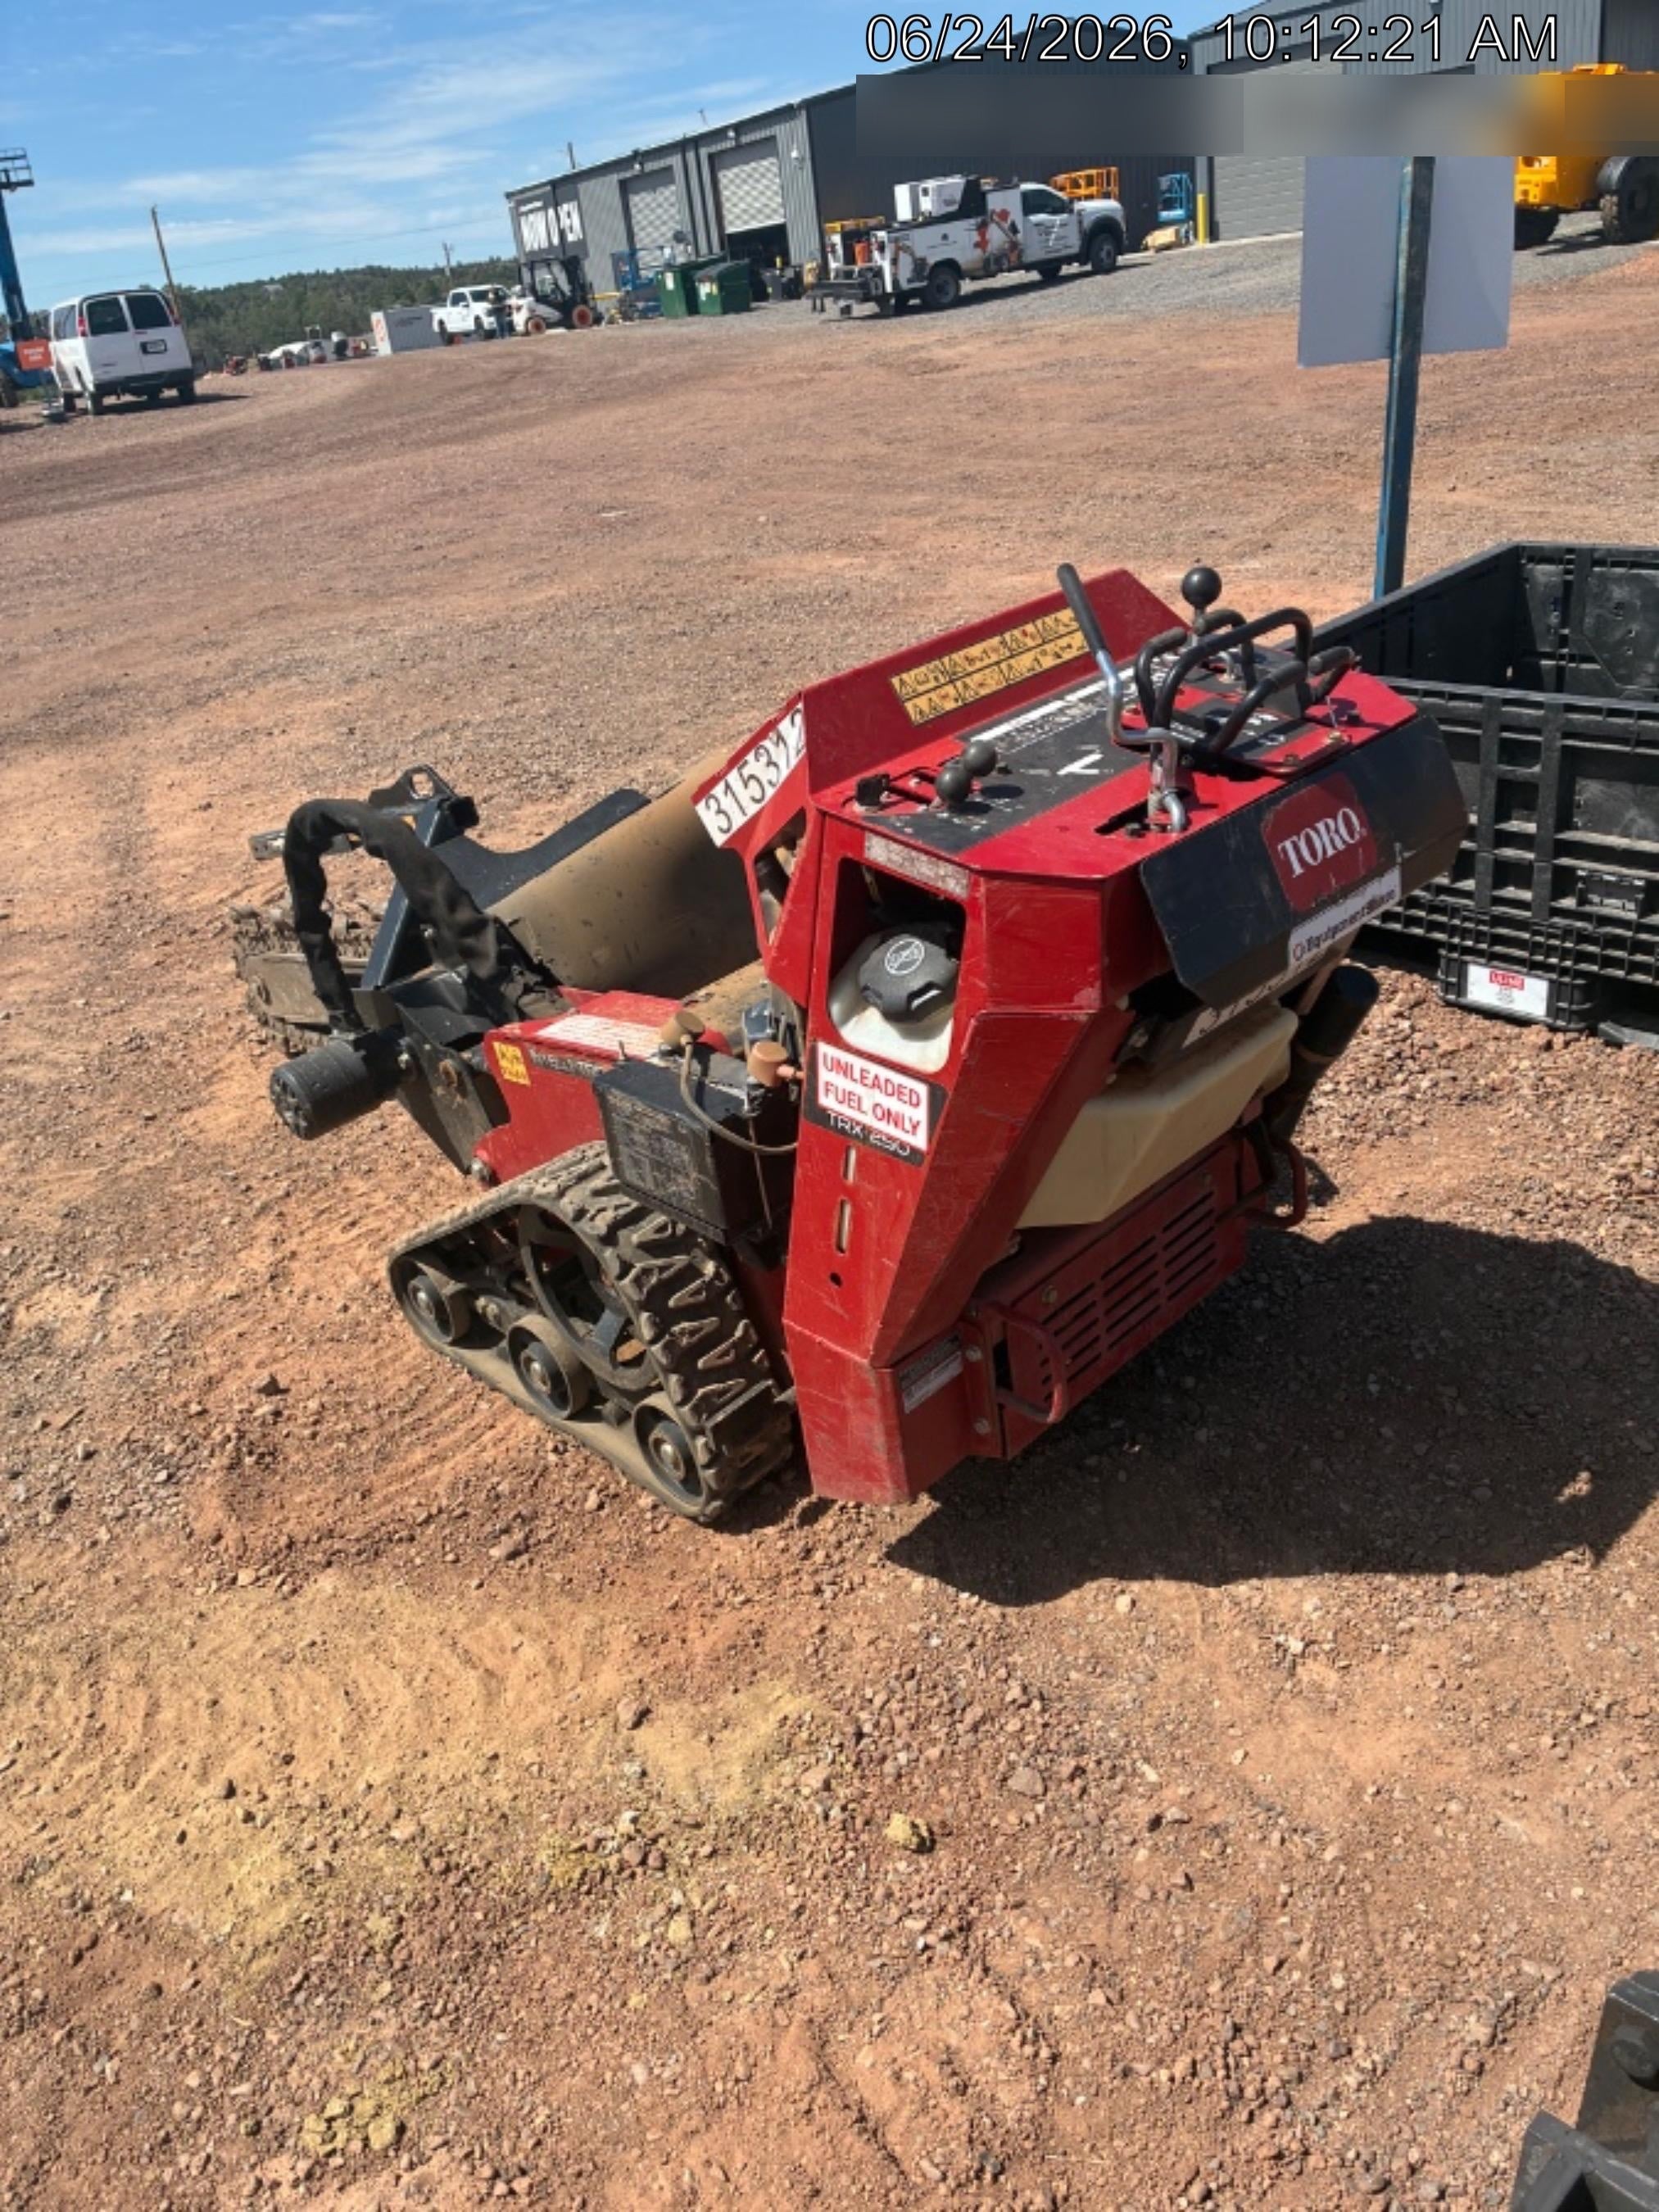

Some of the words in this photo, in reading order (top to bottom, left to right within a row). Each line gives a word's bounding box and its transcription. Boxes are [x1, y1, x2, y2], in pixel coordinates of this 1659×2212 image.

[1277, 807, 1361, 879] TORO
[823, 1052, 921, 1109] UNLEADED
[823, 1080, 868, 1117] FUEL
[872, 1102, 922, 1137] ONLY
